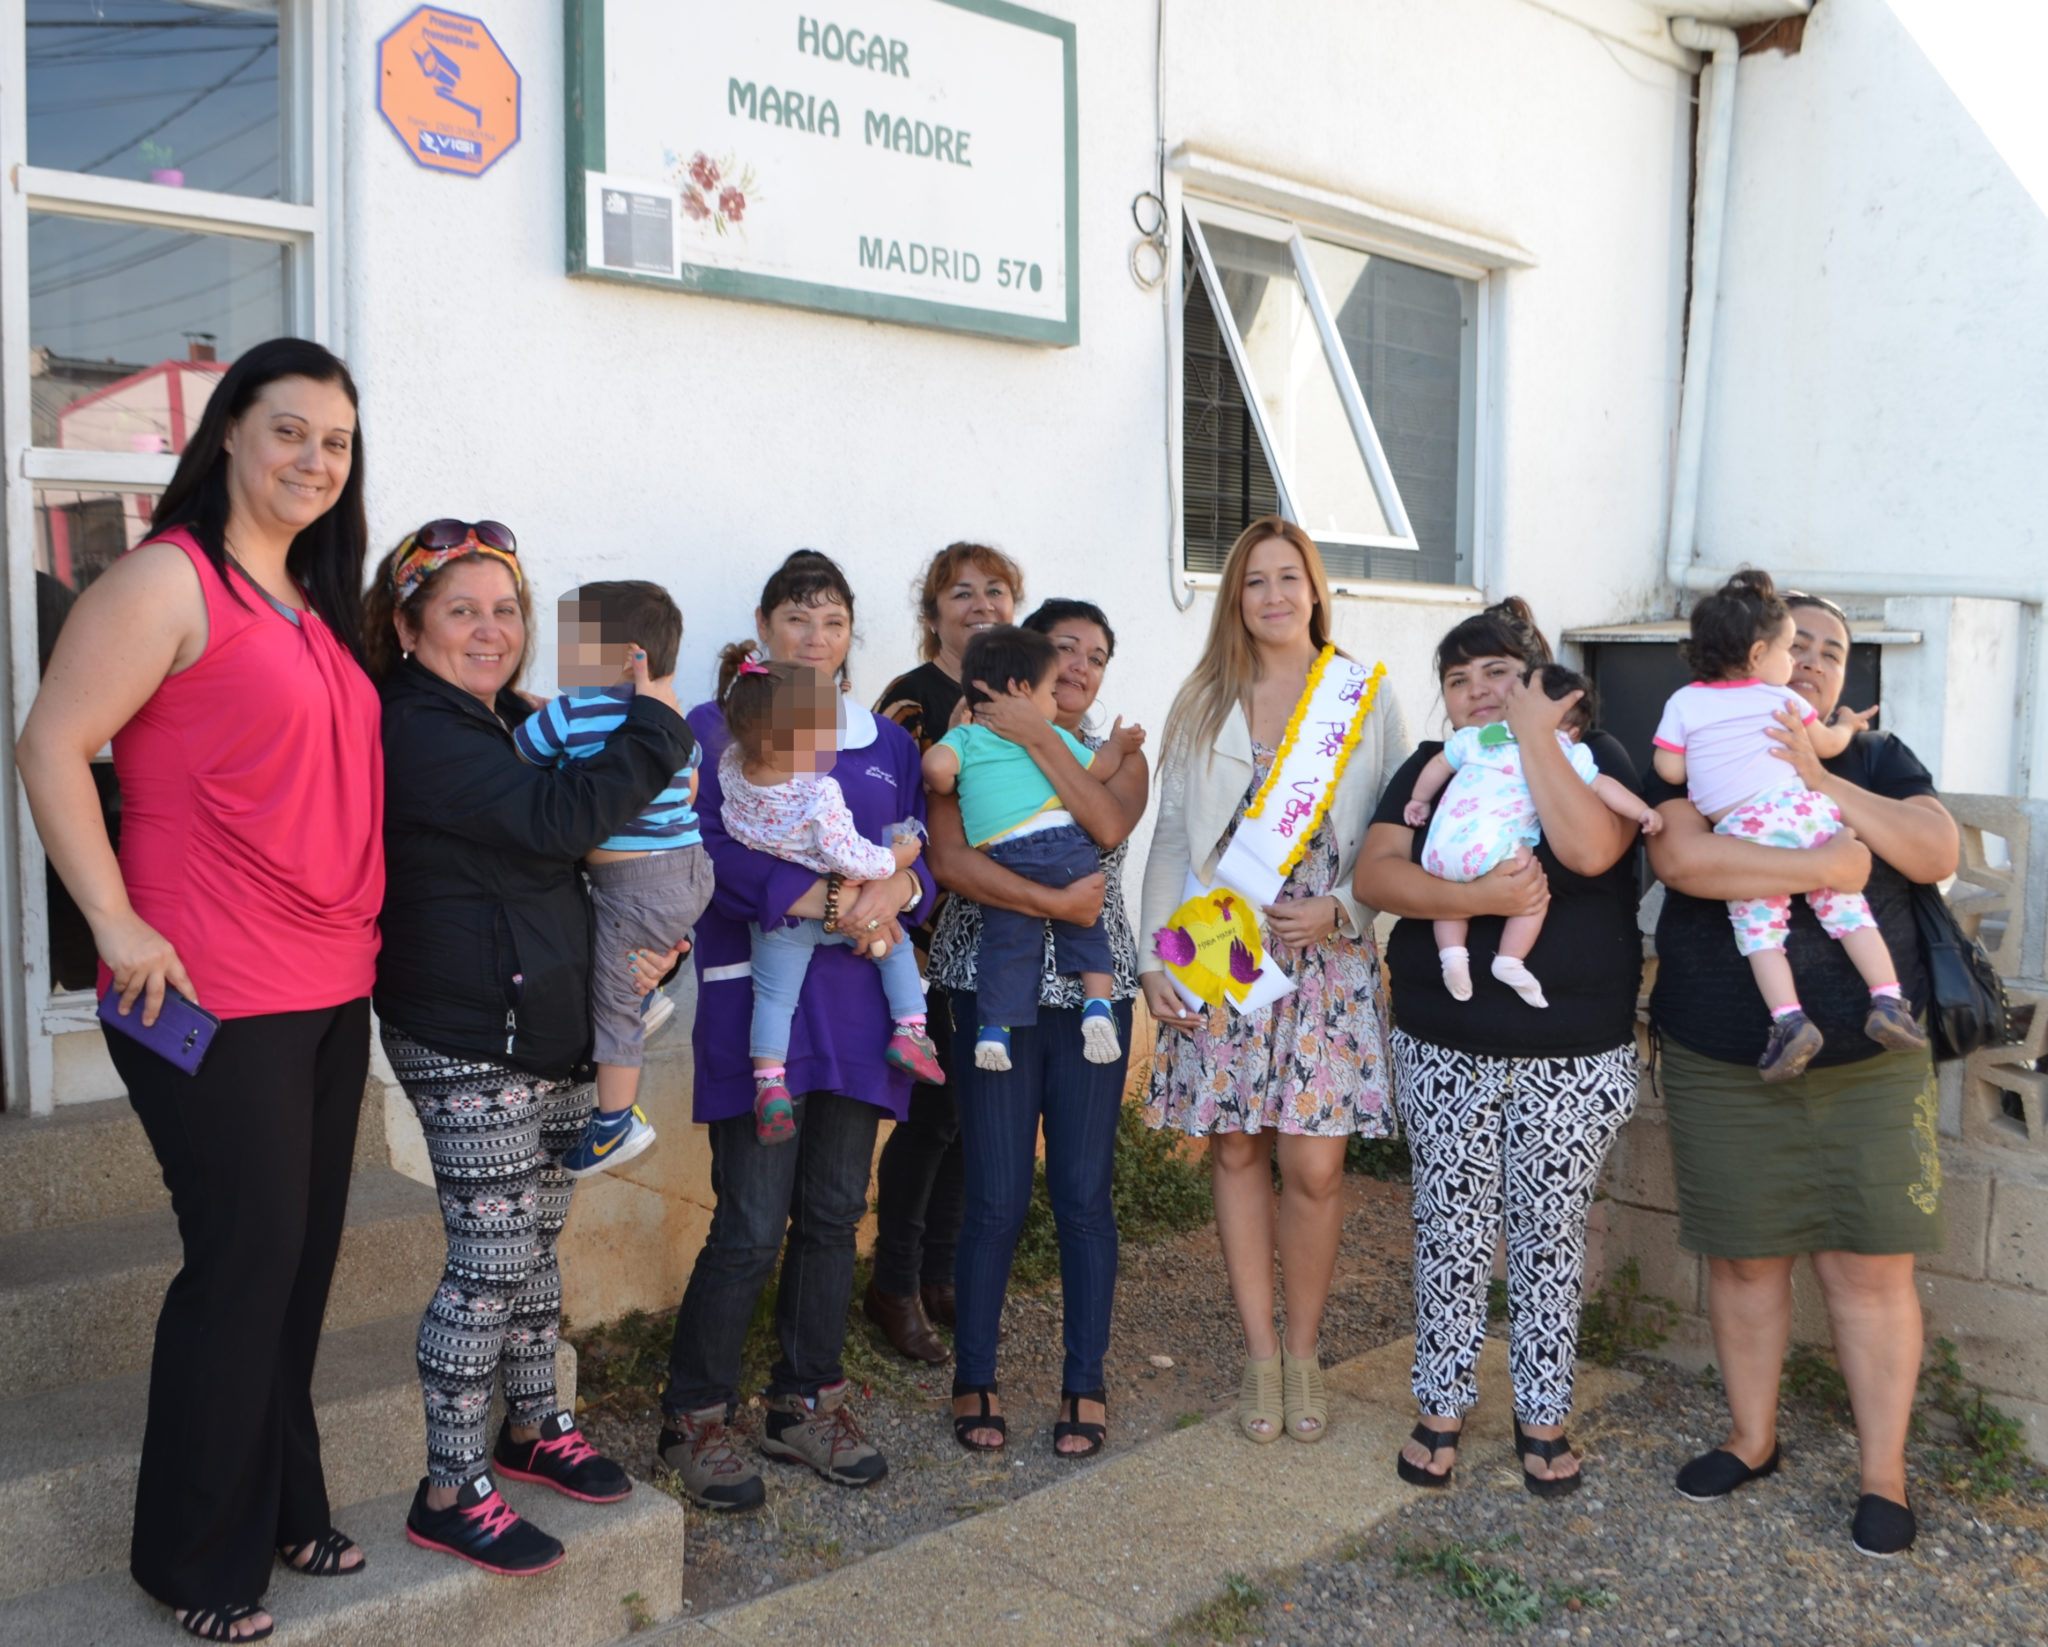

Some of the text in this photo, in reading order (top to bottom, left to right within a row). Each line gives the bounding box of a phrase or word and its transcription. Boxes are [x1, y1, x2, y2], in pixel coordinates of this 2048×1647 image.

[798, 16, 909, 77] HOGAR
[728, 77, 972, 167] MARIA MADRE
[859, 236, 1043, 292] MADRID 570
